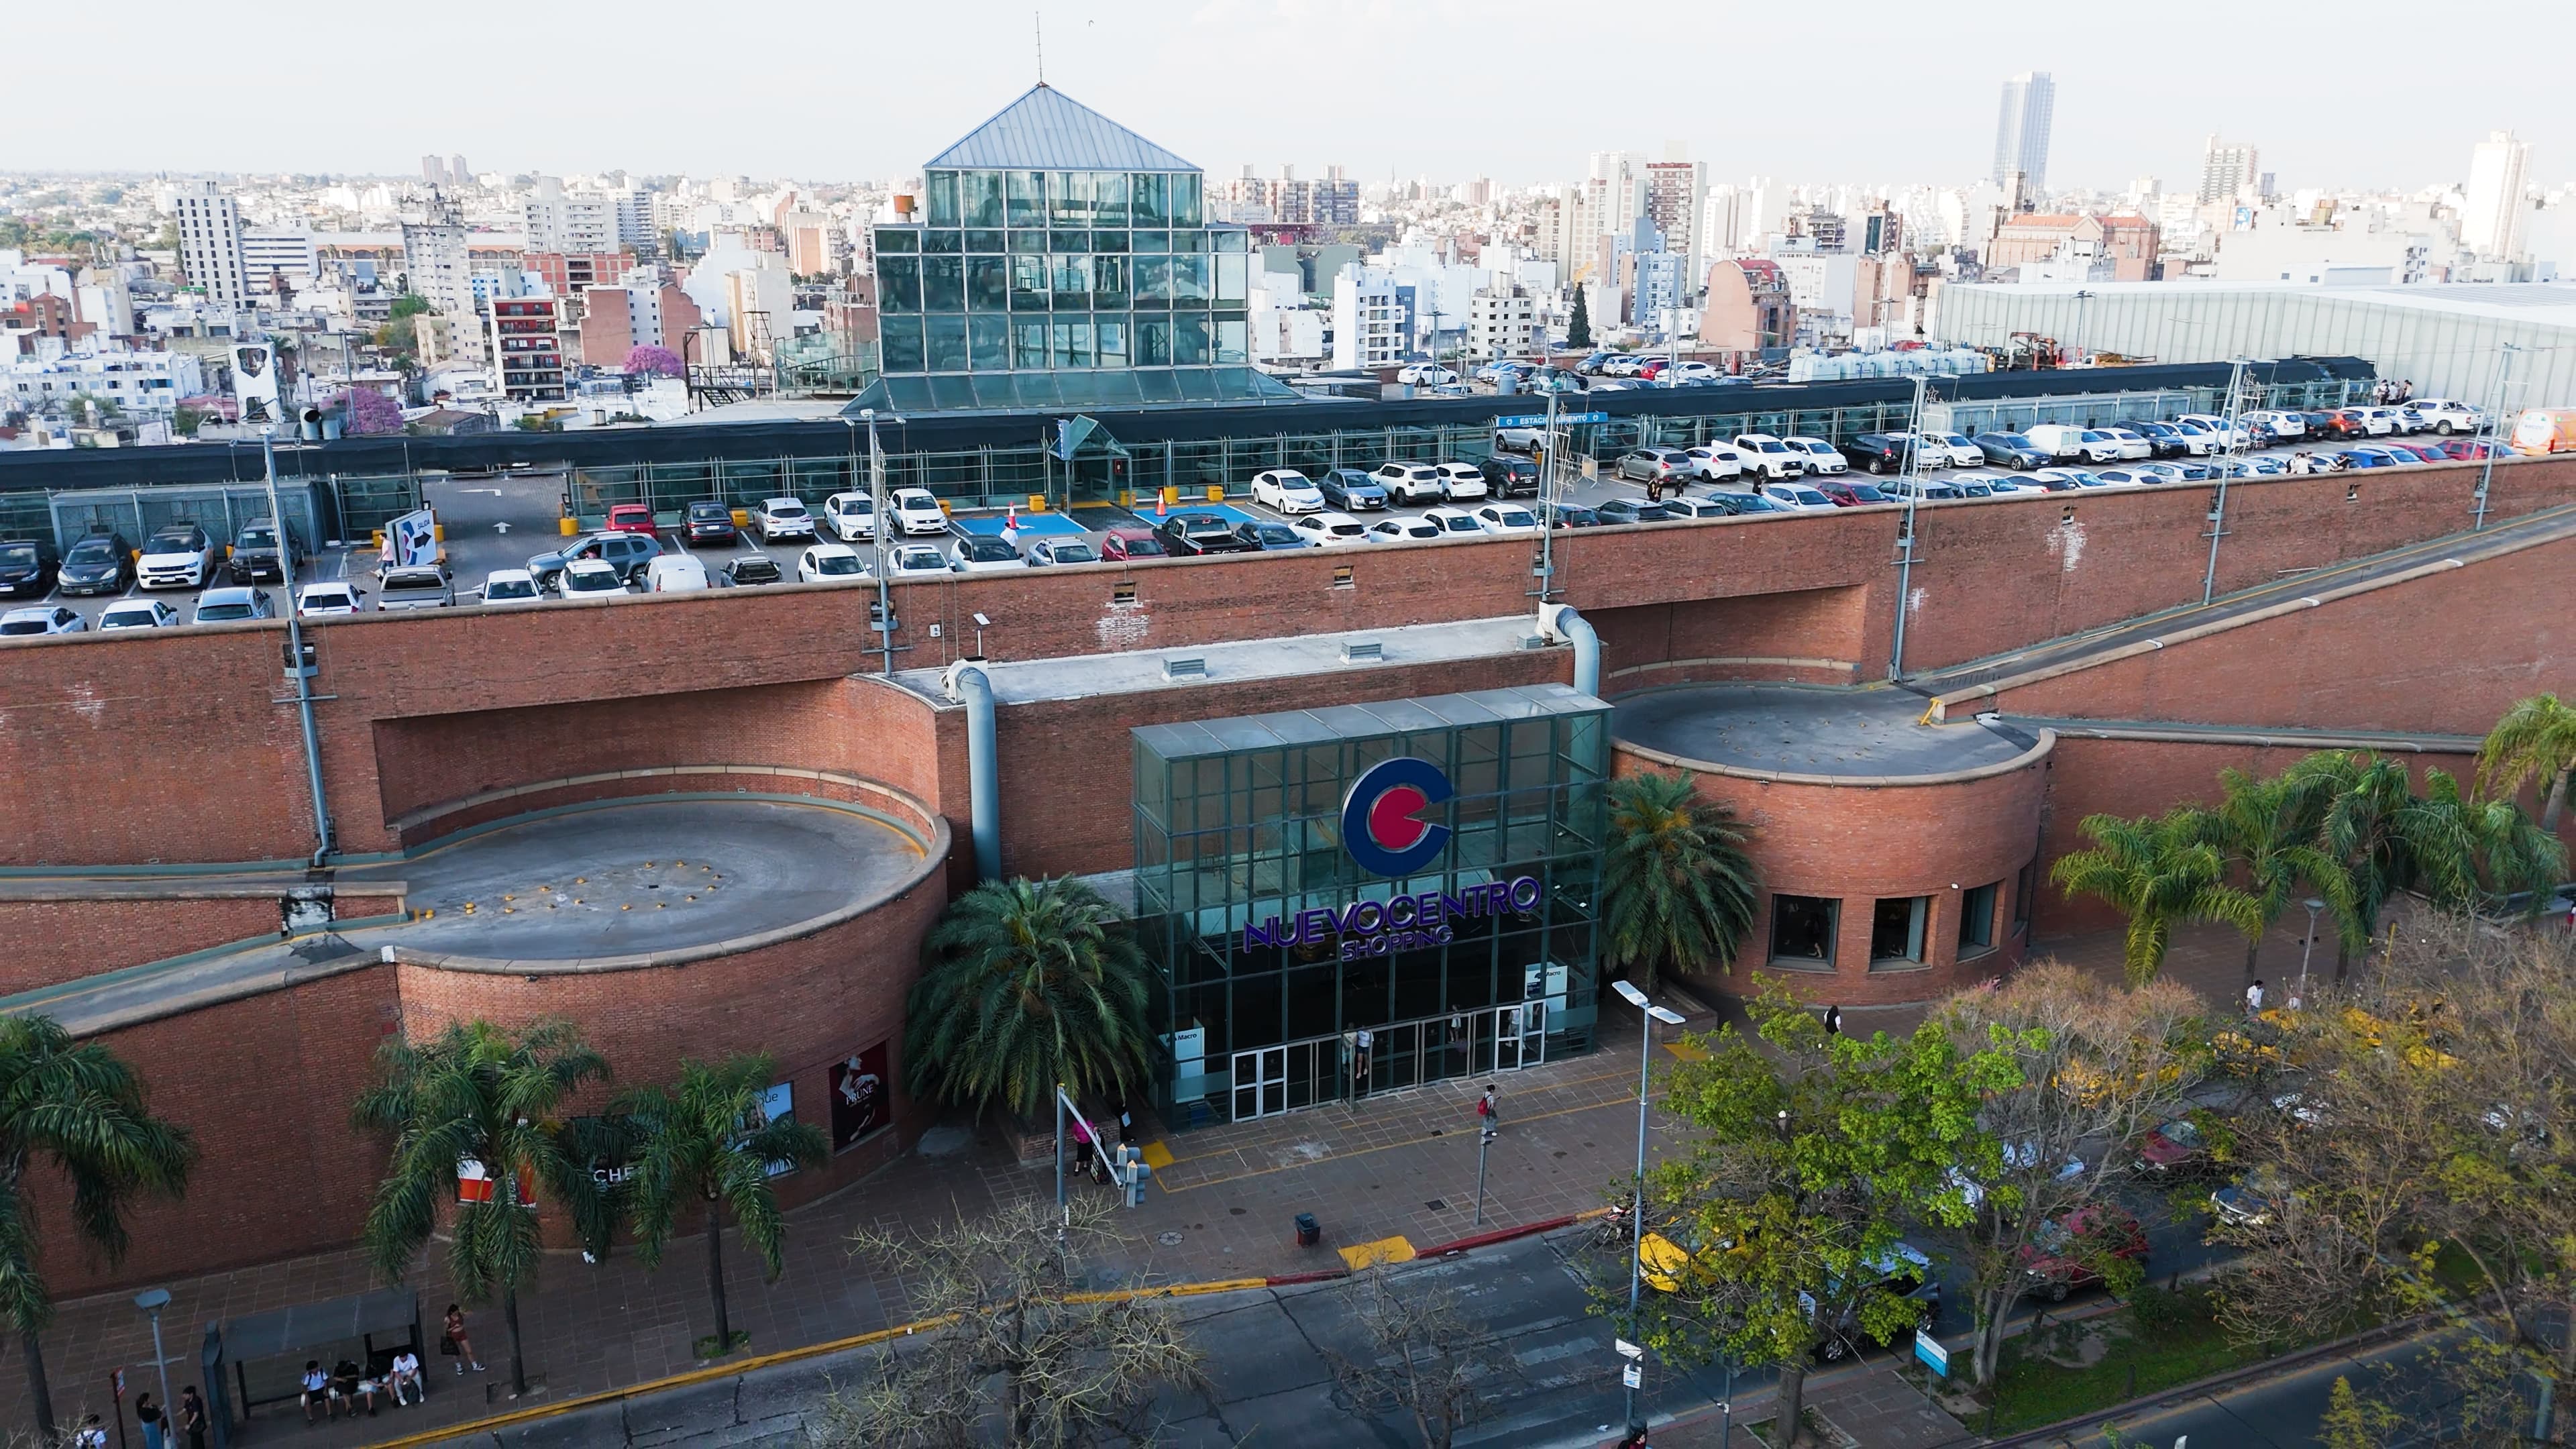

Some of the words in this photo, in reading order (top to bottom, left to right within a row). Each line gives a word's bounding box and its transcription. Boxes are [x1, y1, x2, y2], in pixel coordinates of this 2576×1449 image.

[1244, 875, 1542, 953] NUEVOCENTRO
[1342, 925, 1454, 961] SHOPPING
[1177, 1033, 1197, 1041] Macro
